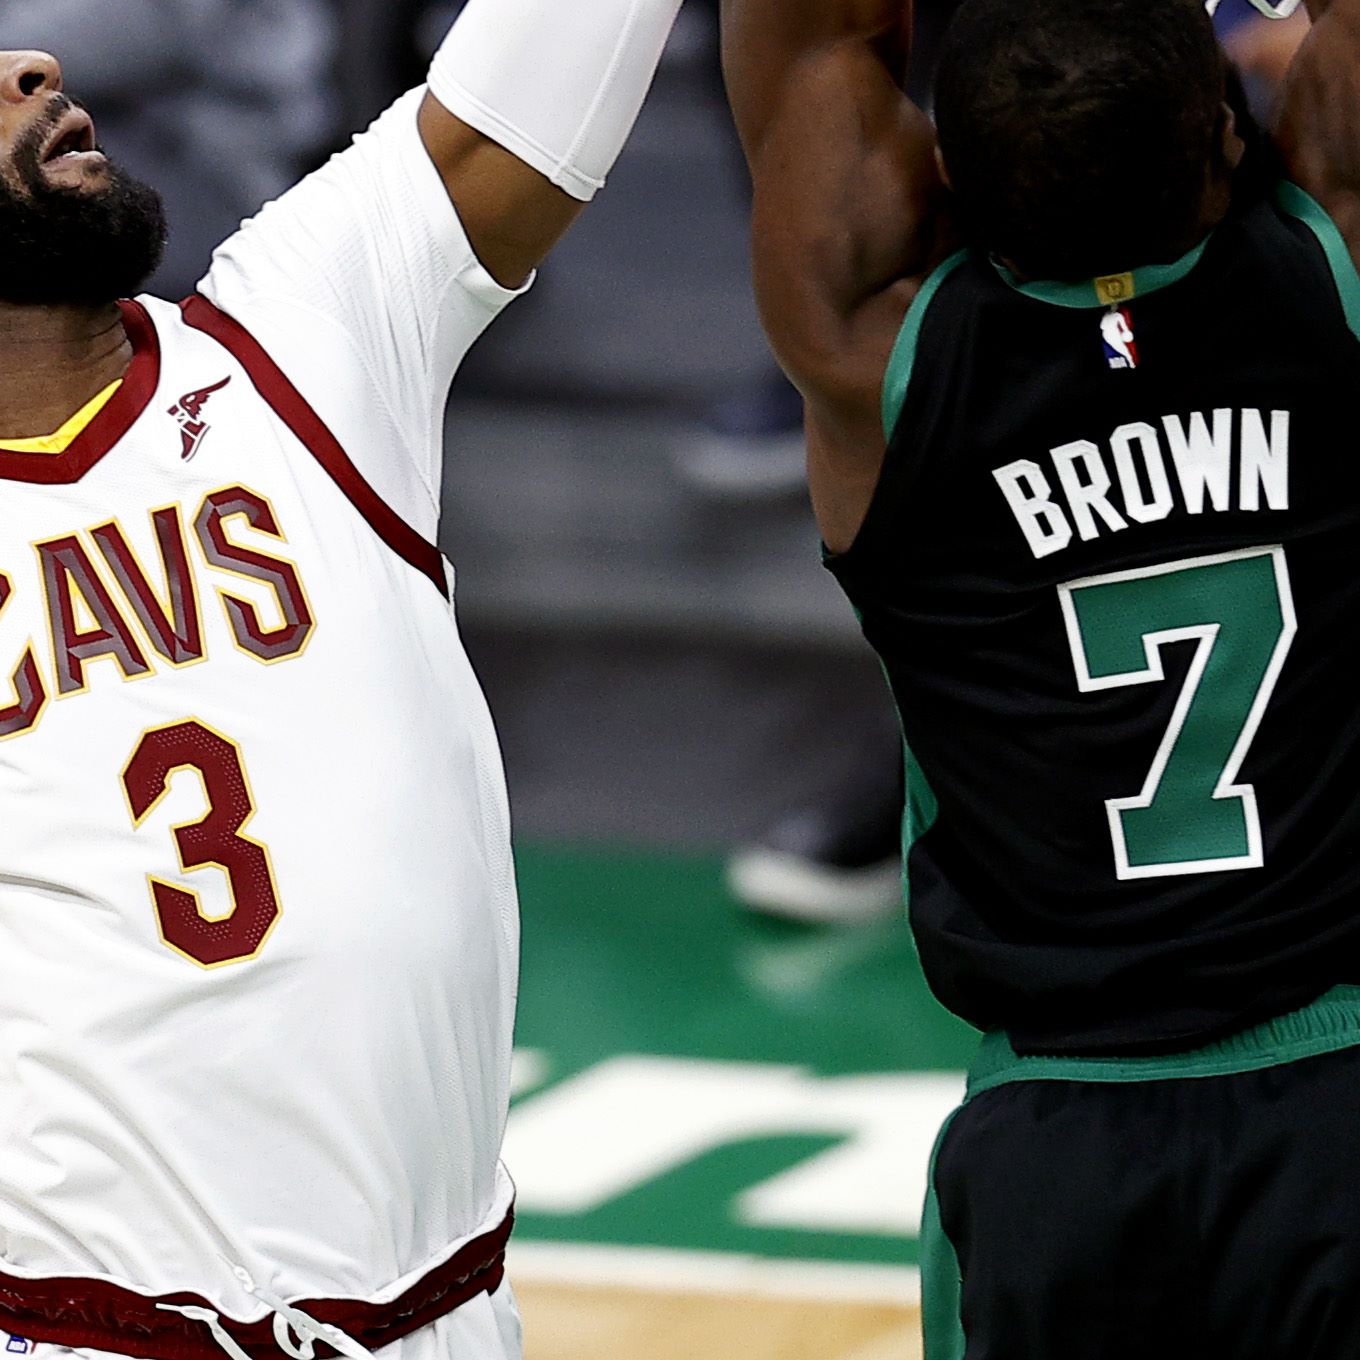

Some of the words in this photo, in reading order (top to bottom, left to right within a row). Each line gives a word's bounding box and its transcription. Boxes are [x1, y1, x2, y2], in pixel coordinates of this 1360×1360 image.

[991, 407, 1290, 560] BROWN
[1056, 543, 1298, 880] 7
[120, 716, 283, 970] 3
